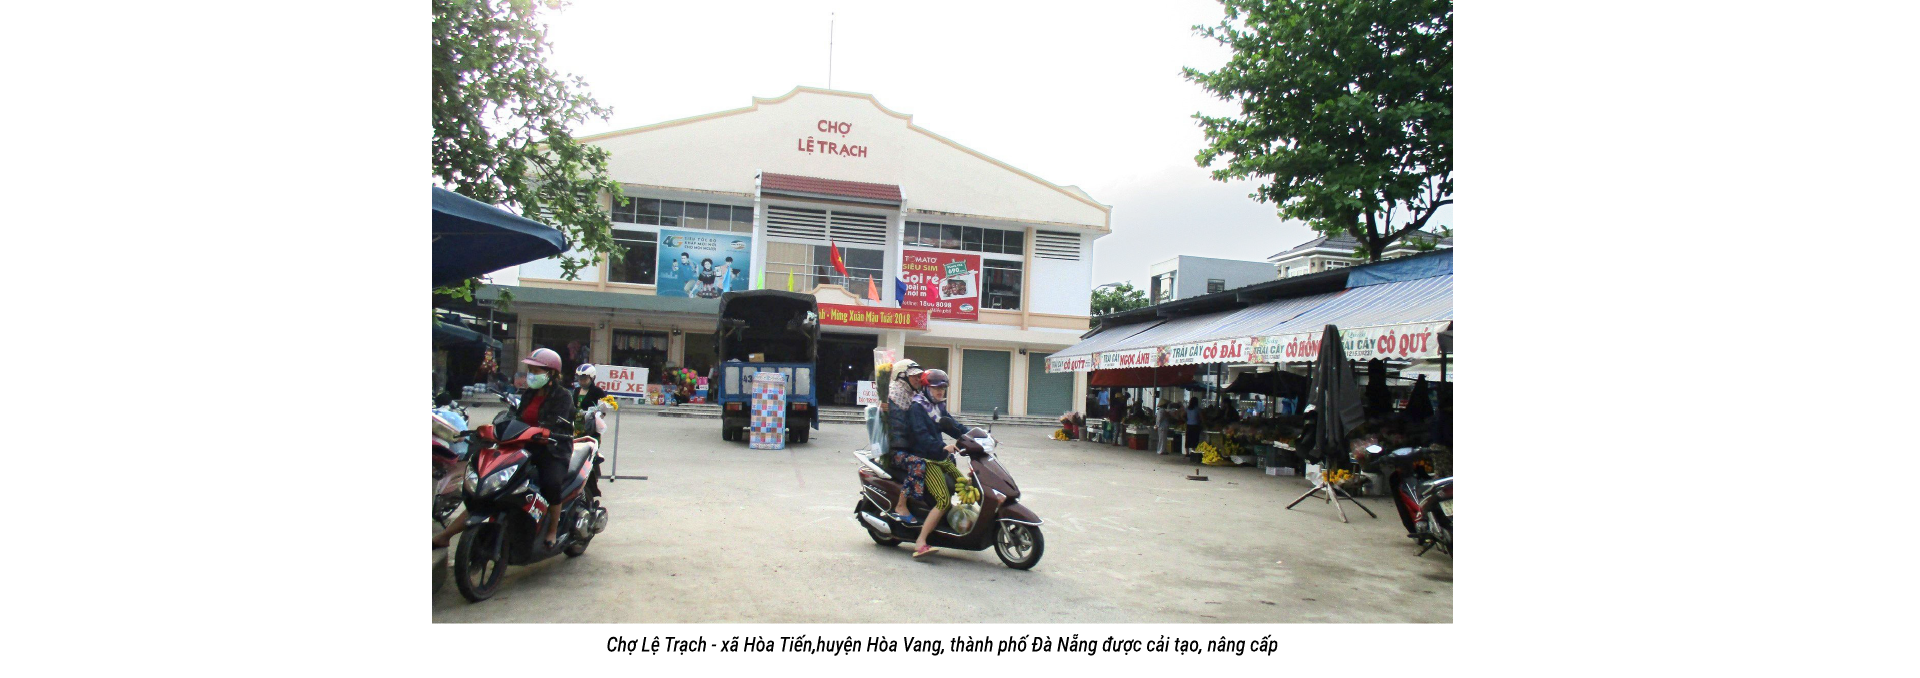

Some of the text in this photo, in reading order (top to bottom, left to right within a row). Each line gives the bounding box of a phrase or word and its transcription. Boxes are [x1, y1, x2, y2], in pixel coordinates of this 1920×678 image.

[817, 119, 852, 138] CHỢ
[798, 136, 868, 158] LỆ TRẠCH
[662, 235, 683, 248] 4G
[902, 263, 921, 271] SIÊU
[922, 264, 938, 272] SIM
[902, 271, 924, 285] Gọi
[831, 309, 848, 324] Mừng
[850, 309, 865, 322] Xuân
[866, 311, 879, 323] Mậu
[895, 312, 911, 325] 2018
[1285, 336, 1298, 358] CÔ
[1357, 337, 1376, 351] CÂY
[1377, 329, 1396, 354] CÔ
[1398, 326, 1432, 358] QUÝ
[1203, 342, 1218, 360] CÔ
[1120, 354, 1135, 368] NGỌC
[609, 368, 635, 380] BÃI
[596, 380, 645, 393] GIỮ XE
